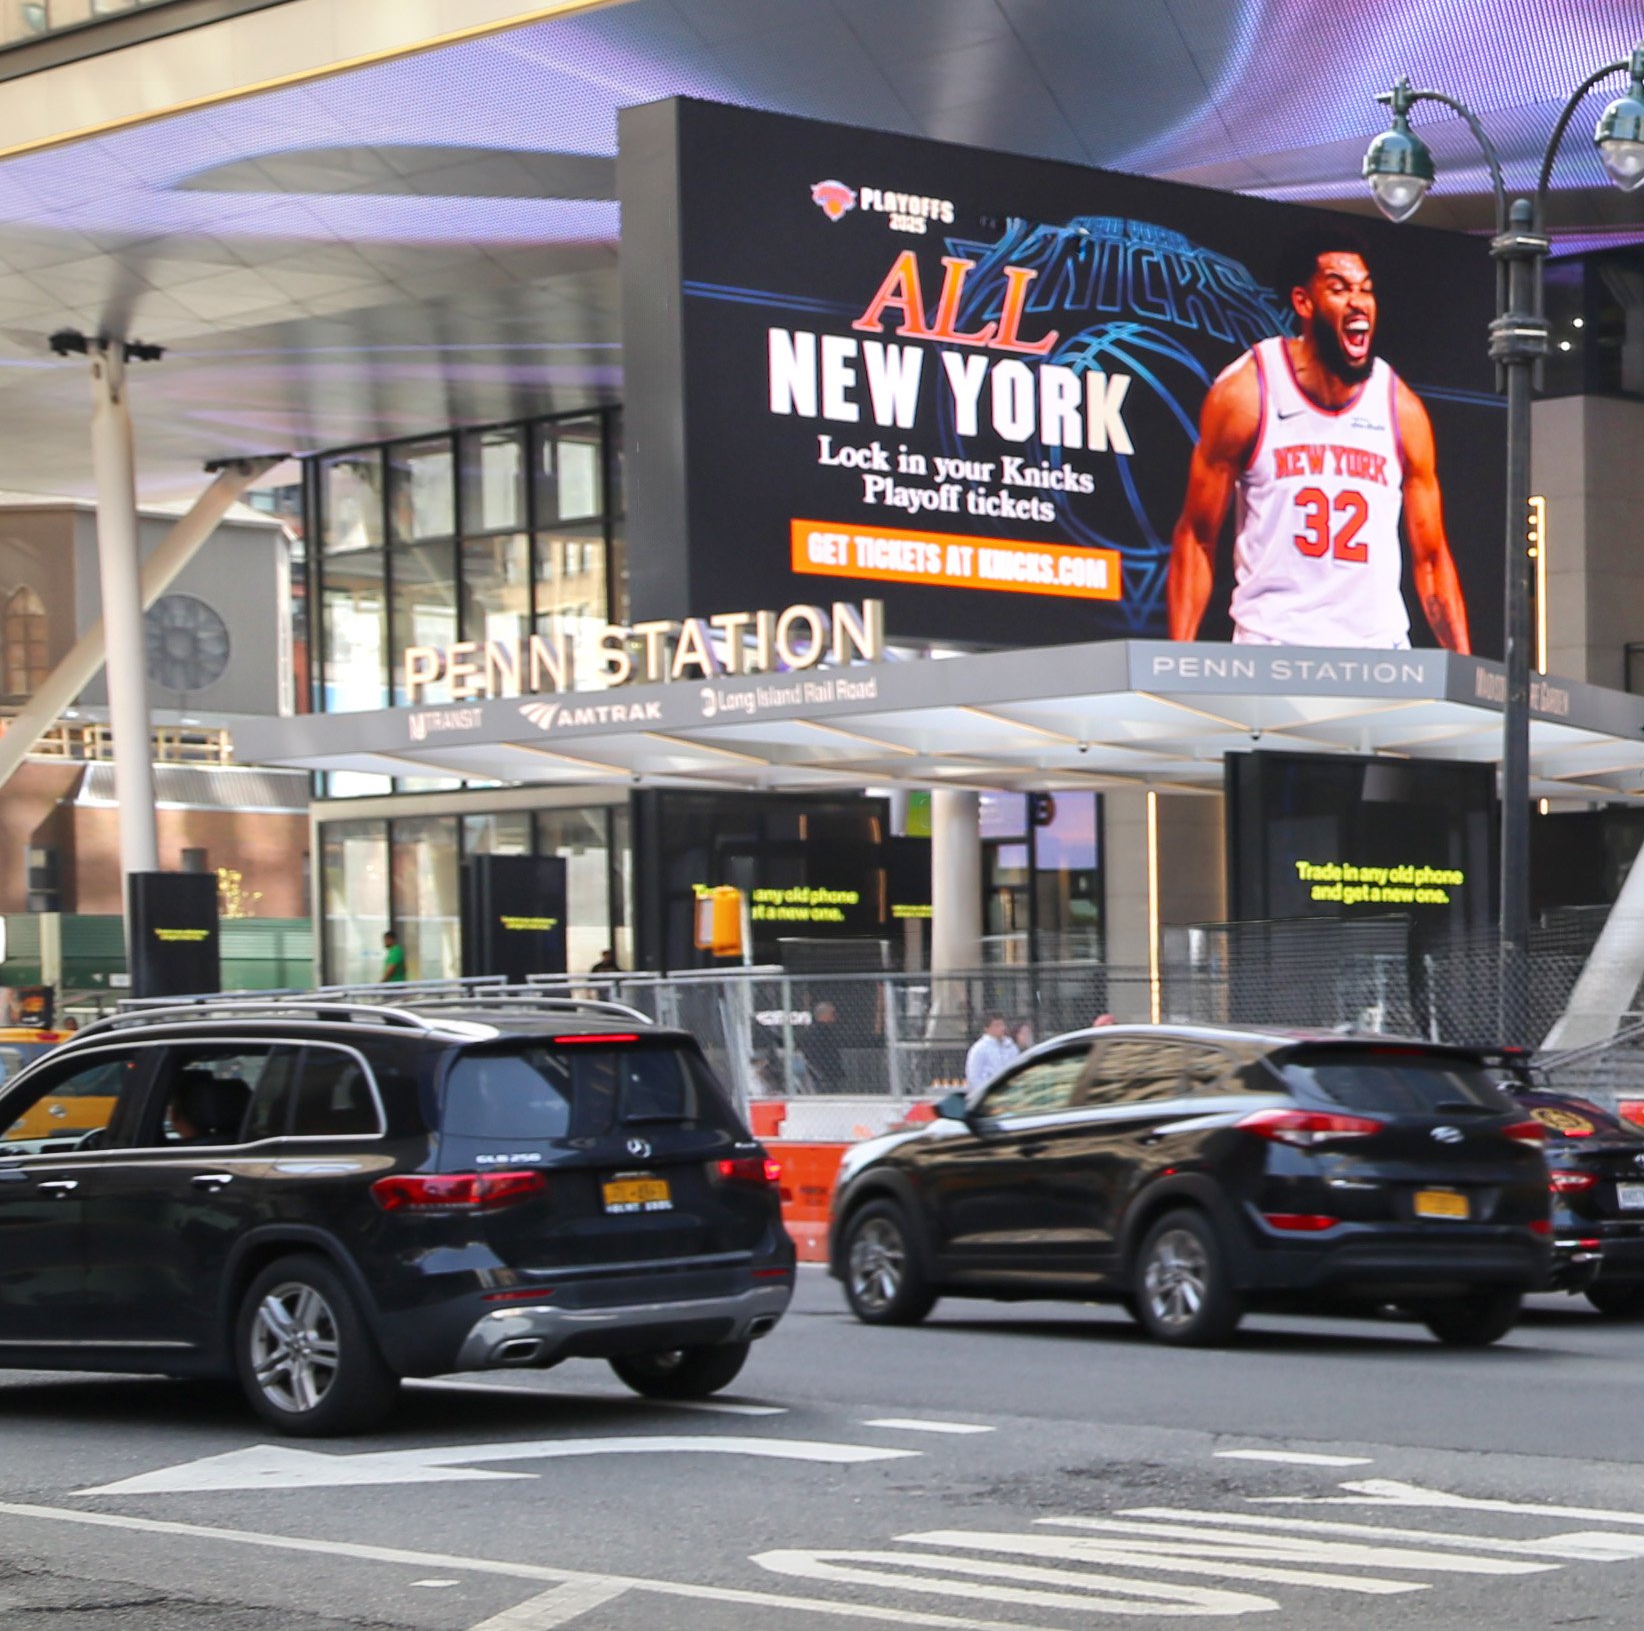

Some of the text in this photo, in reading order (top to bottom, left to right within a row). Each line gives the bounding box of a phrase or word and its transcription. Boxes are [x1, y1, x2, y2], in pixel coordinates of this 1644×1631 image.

[860, 187, 954, 223] PLAYOFFS
[889, 213, 927, 234] 2025
[852, 250, 1059, 354] ALL
[768, 327, 1134, 455] NEW YORK
[817, 435, 1095, 494] Lock in your Knicks
[1274, 444, 1389, 487] NEW YORK
[862, 474, 1056, 523] Playoff tickets
[1293, 487, 1369, 563] 32
[808, 532, 1108, 589] GET TICKETS AT KNICKS.COM
[404, 598, 885, 703] PENN STATION
[1152, 656, 1425, 684] PENN STATION
[557, 701, 663, 728] AMTRAK
[717, 676, 878, 715] Long Island Rail Road
[1295, 861, 1464, 886] Trade in any old phone
[777, 906, 810, 921] new
[810, 907, 845, 921] one.
[784, 886, 810, 903] old
[810, 887, 859, 906] phone
[1311, 883, 1450, 905] and get a new one.
